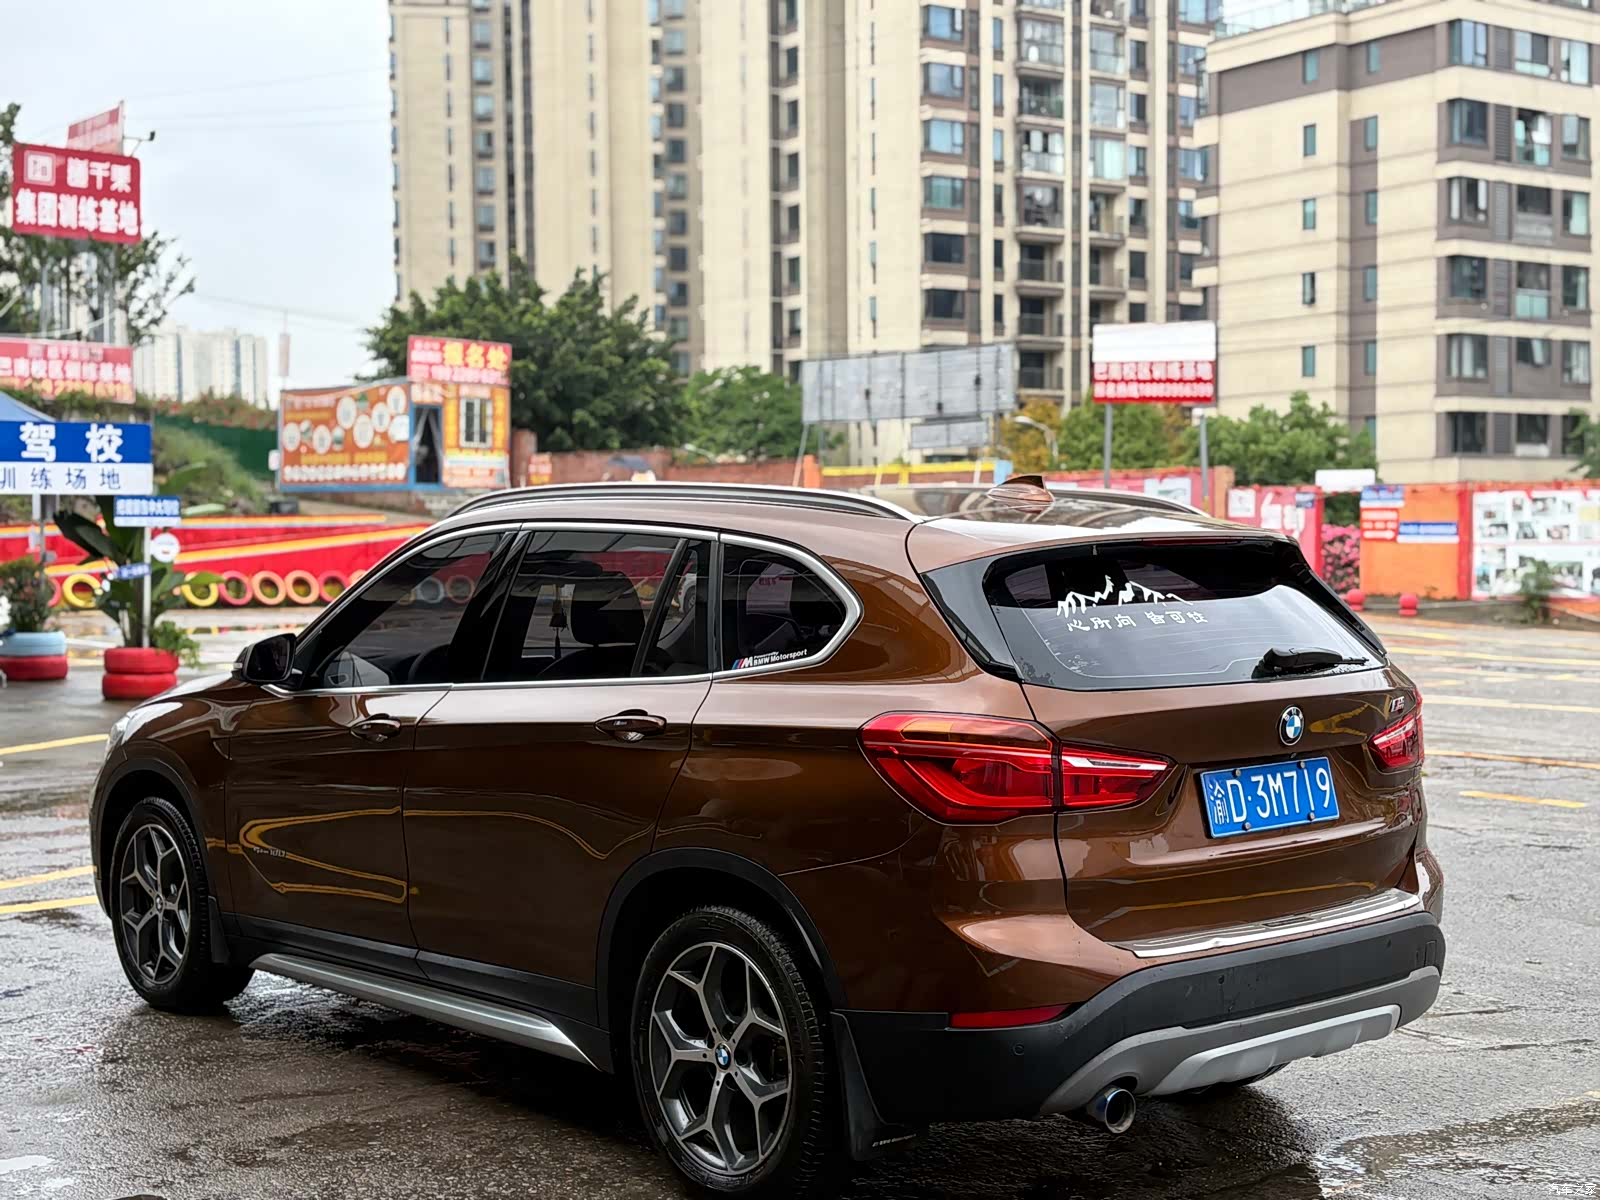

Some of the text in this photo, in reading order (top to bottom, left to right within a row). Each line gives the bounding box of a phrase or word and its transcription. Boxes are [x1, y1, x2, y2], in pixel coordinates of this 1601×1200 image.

[20, 422, 123, 462] 驾校
[1067, 614, 1136, 632] 心所向
[753, 656, 770, 666] BMW
[771, 649, 807, 662] Motorsport
